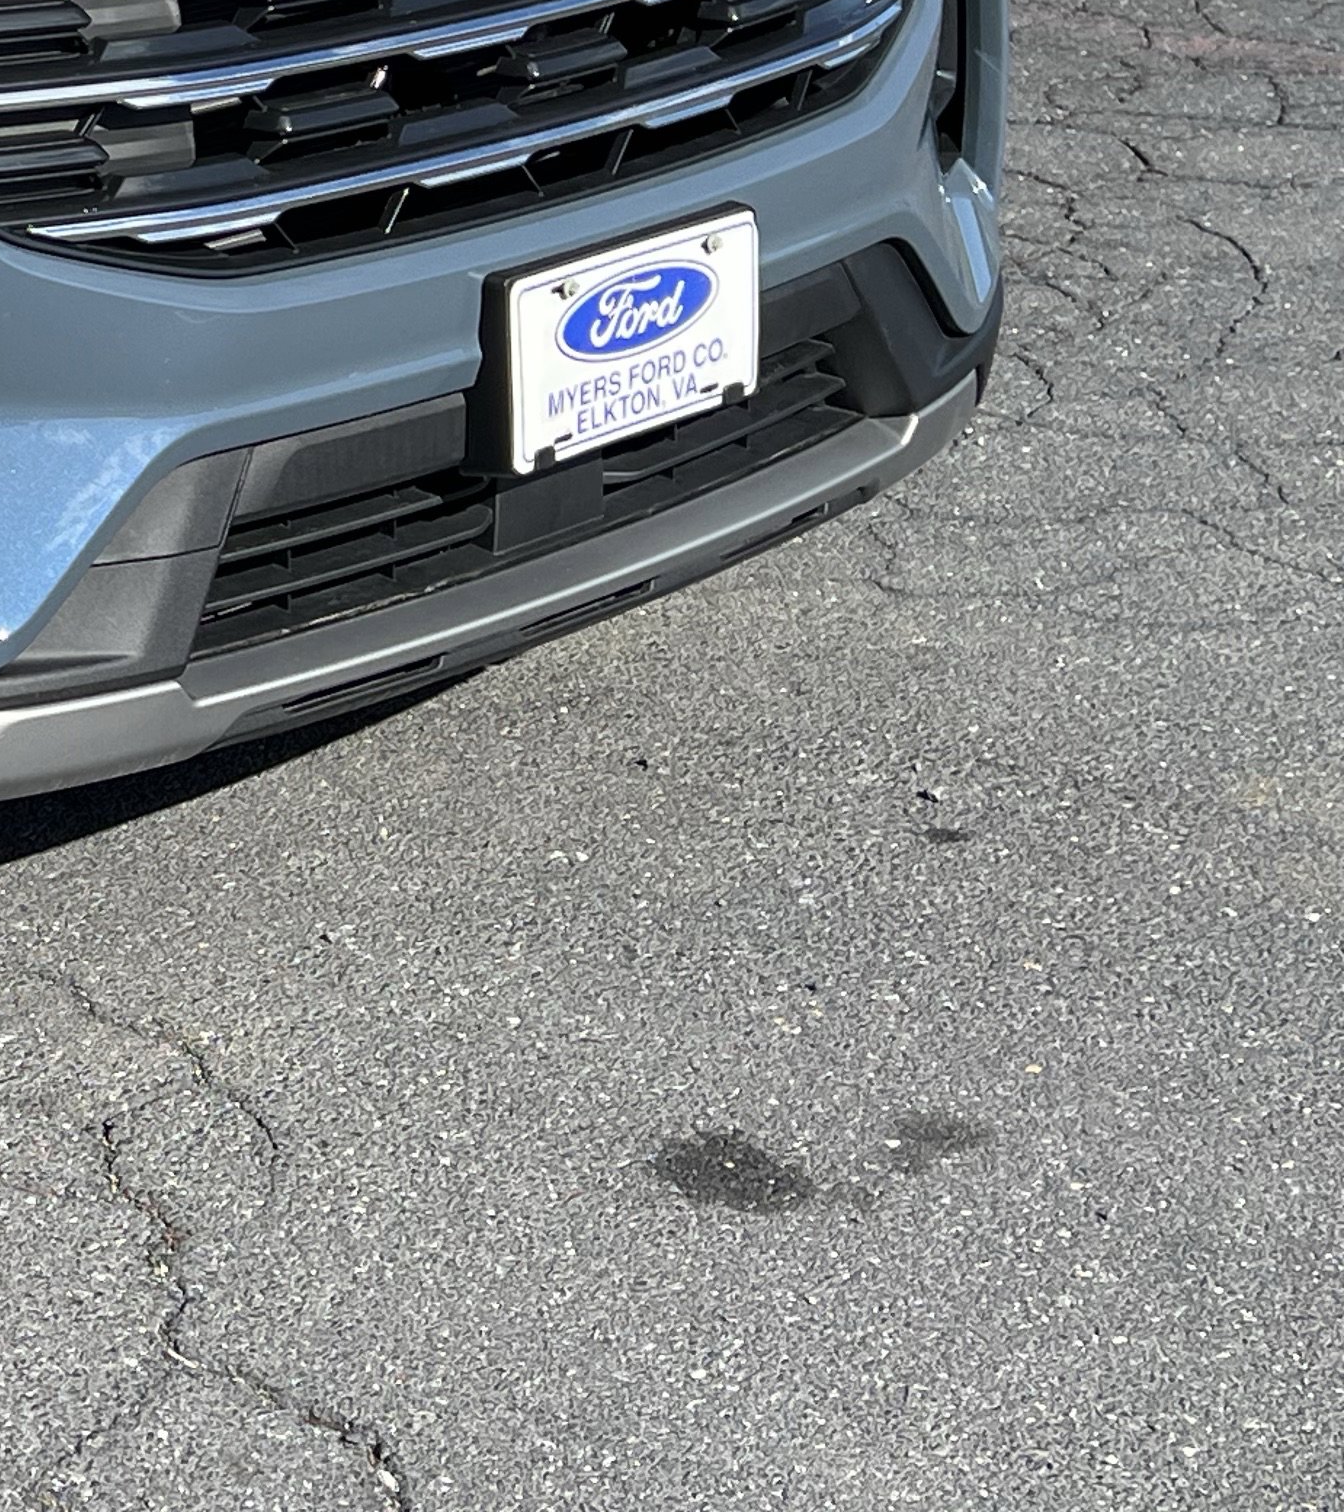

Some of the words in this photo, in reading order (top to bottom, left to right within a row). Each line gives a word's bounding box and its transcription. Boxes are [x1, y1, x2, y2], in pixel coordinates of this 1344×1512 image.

[589, 274, 686, 349] Ford
[548, 370, 622, 418] MYERS
[629, 350, 686, 388] FORD
[693, 337, 729, 367] CO.
